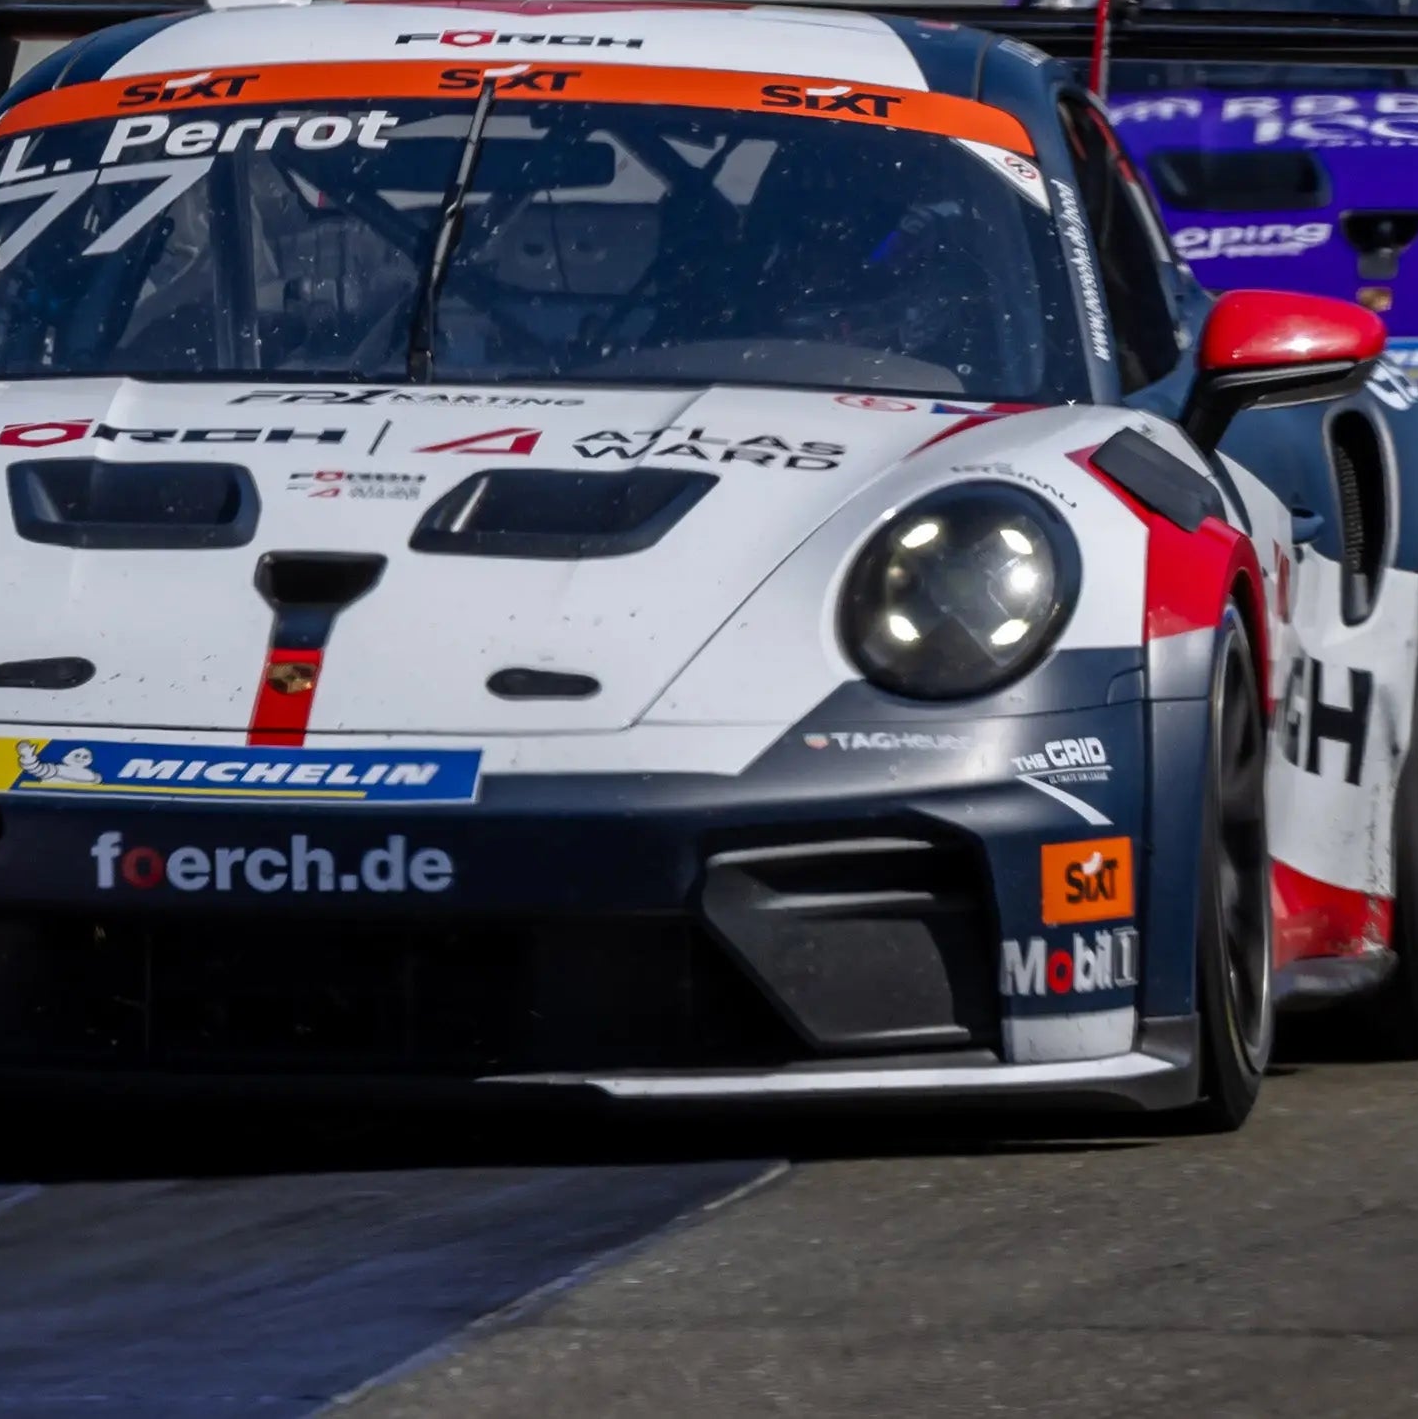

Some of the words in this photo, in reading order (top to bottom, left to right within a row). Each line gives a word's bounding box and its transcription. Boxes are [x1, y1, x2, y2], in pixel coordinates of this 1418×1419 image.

[117, 72, 260, 108] SIXT
[438, 63, 582, 93] SIXT
[760, 83, 903, 120] SIXT
[99, 109, 401, 165] Perrot
[571, 442, 841, 471] WARD
[576, 425, 847, 456] ATLAS
[1044, 737, 1107, 766] GRID
[117, 757, 441, 786] MICHELIN
[90, 830, 455, 893] foerch.de
[1065, 852, 1119, 903] SIXT
[999, 929, 1113, 998] Mobil
